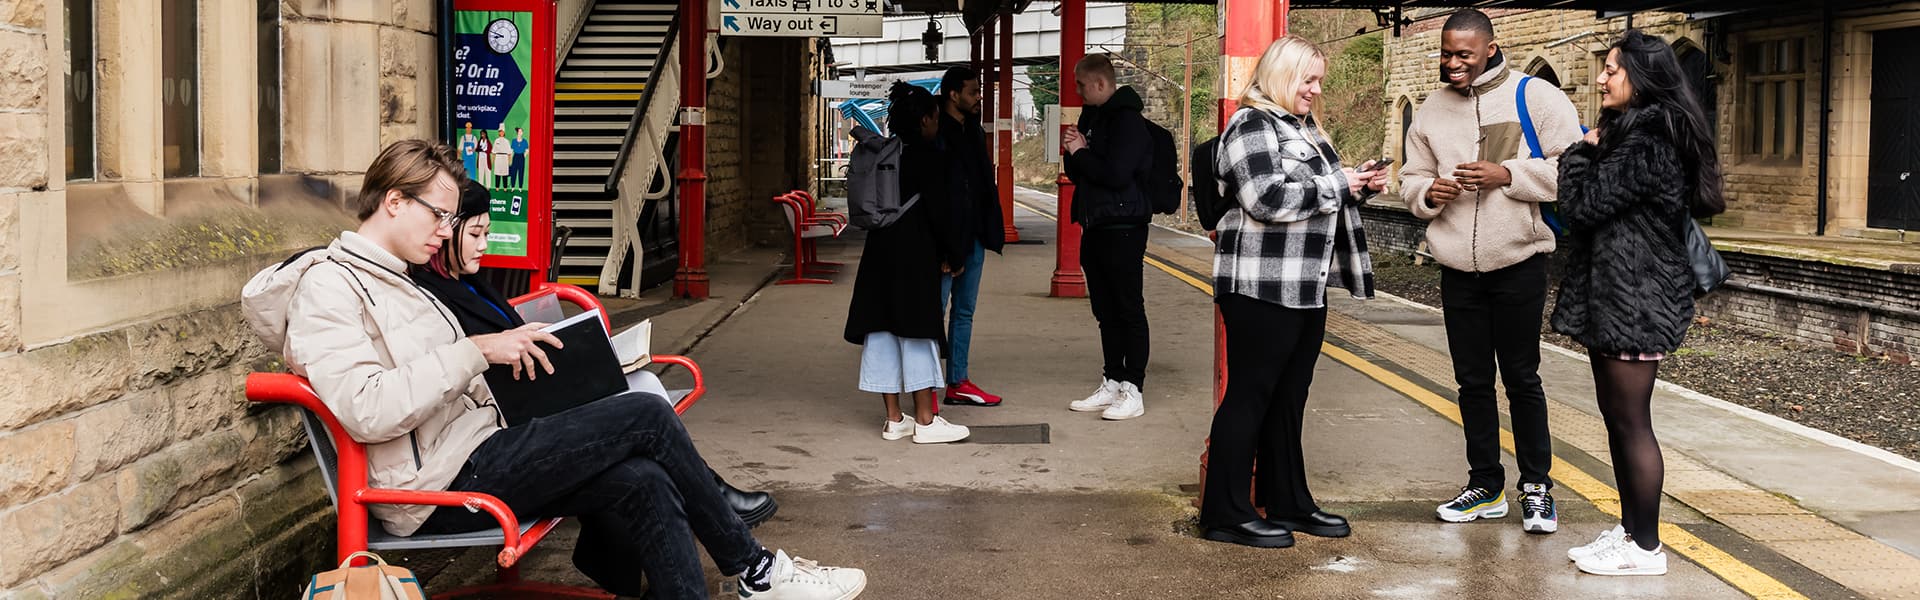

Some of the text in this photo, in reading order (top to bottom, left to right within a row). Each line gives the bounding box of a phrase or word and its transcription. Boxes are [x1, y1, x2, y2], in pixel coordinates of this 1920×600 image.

[828, 0, 843, 8] to
[848, 0, 859, 8] 3
[747, 17, 813, 32] Way out
[468, 64, 484, 78] Or
[485, 64, 499, 78] in
[467, 81, 504, 96] time?
[850, 82, 882, 90] Passenger
[467, 104, 497, 112] workplace,
